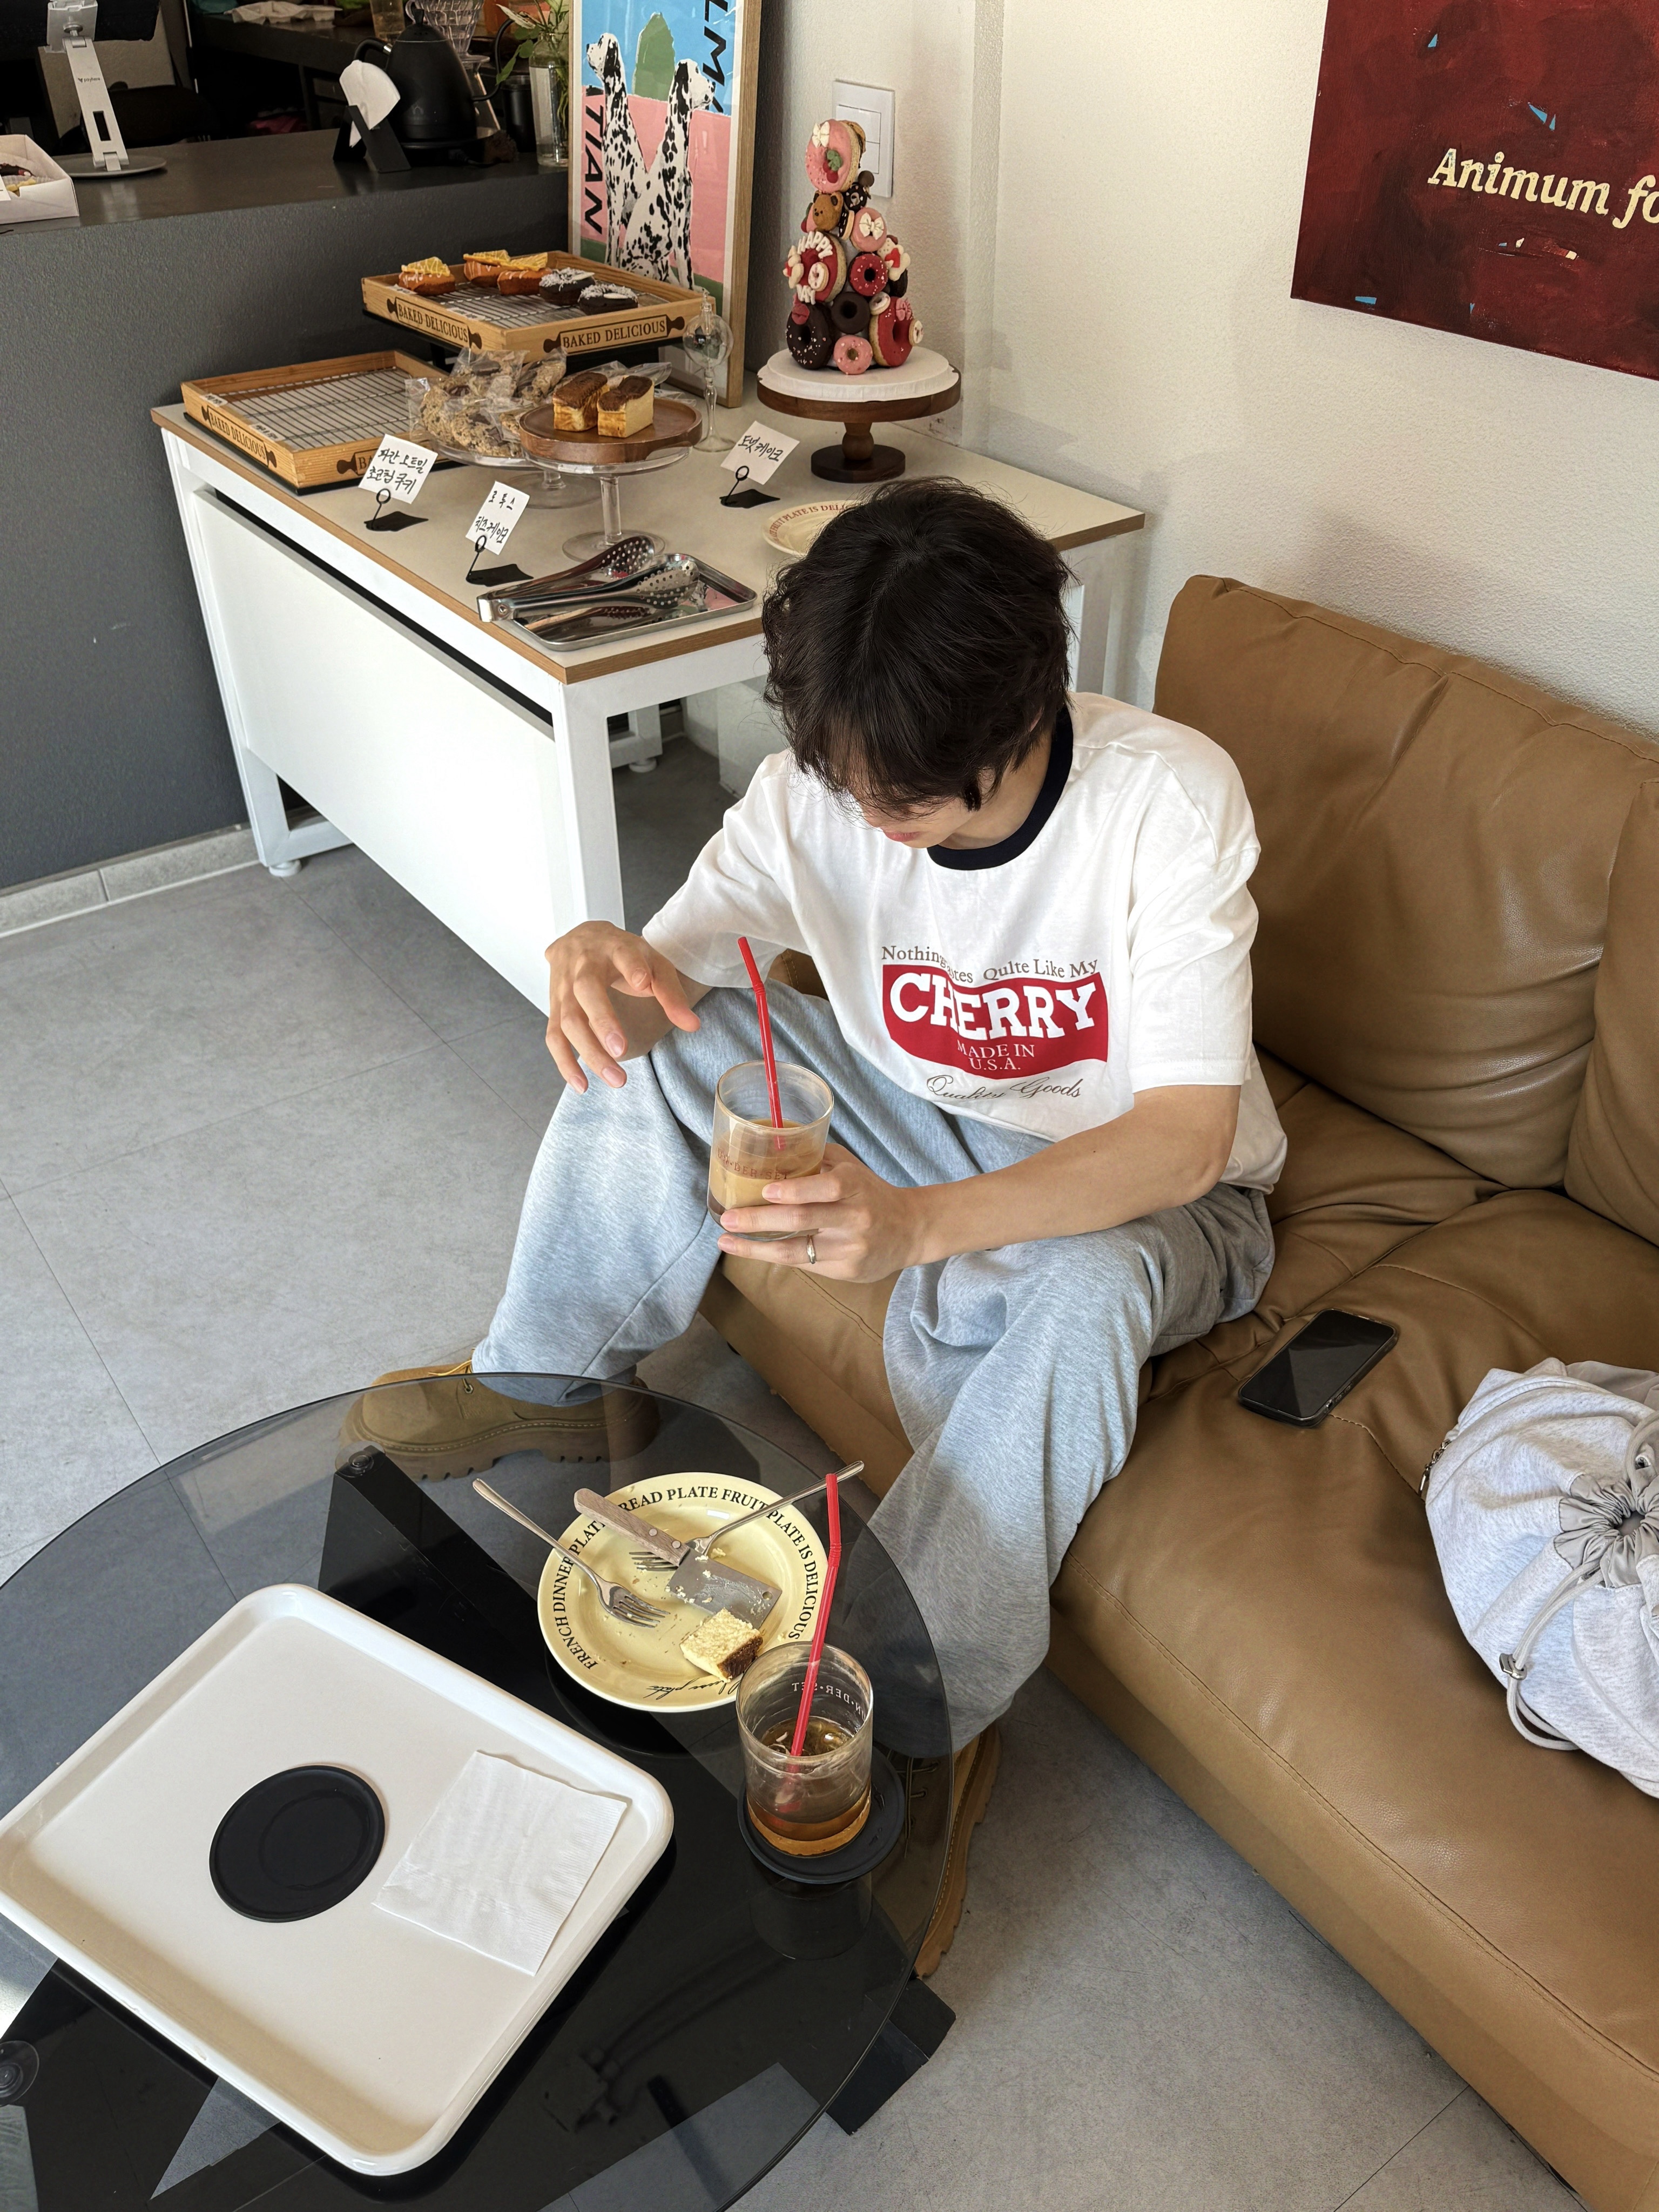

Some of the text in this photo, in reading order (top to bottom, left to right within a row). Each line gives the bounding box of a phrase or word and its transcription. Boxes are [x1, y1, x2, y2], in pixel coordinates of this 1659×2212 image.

[1427, 148, 1610, 215] Animum
[797, 231, 833, 259] HAPPY
[398, 304, 468, 342] BAKED DELICIOUS
[563, 320, 665, 349] BAKED DELICIOUS
[210, 412, 231, 436] BAKED
[231, 426, 266, 460] DELICIOUS
[395, 473, 417, 495] 쿠키
[782, 508, 809, 521] PLATE
[881, 946, 949, 968] Nothing
[1033, 959, 1065, 978] Like
[1070, 959, 1098, 978] My
[890, 972, 1096, 1041] CHERRY
[957, 1040, 1035, 1058] MADE IN
[968, 1057, 1021, 1071] U.S.A.
[1009, 1077, 1083, 1098] Goods
[618, 1491, 663, 1512] READ
[667, 1486, 718, 1501] PLATE
[721, 1488, 769, 1510] FRUIT
[766, 1509, 806, 1546] PLATE
[798, 1543, 813, 1560] IS
[788, 1560, 818, 1640] DELICIOUS
[555, 1616, 599, 1669] FRENCH
